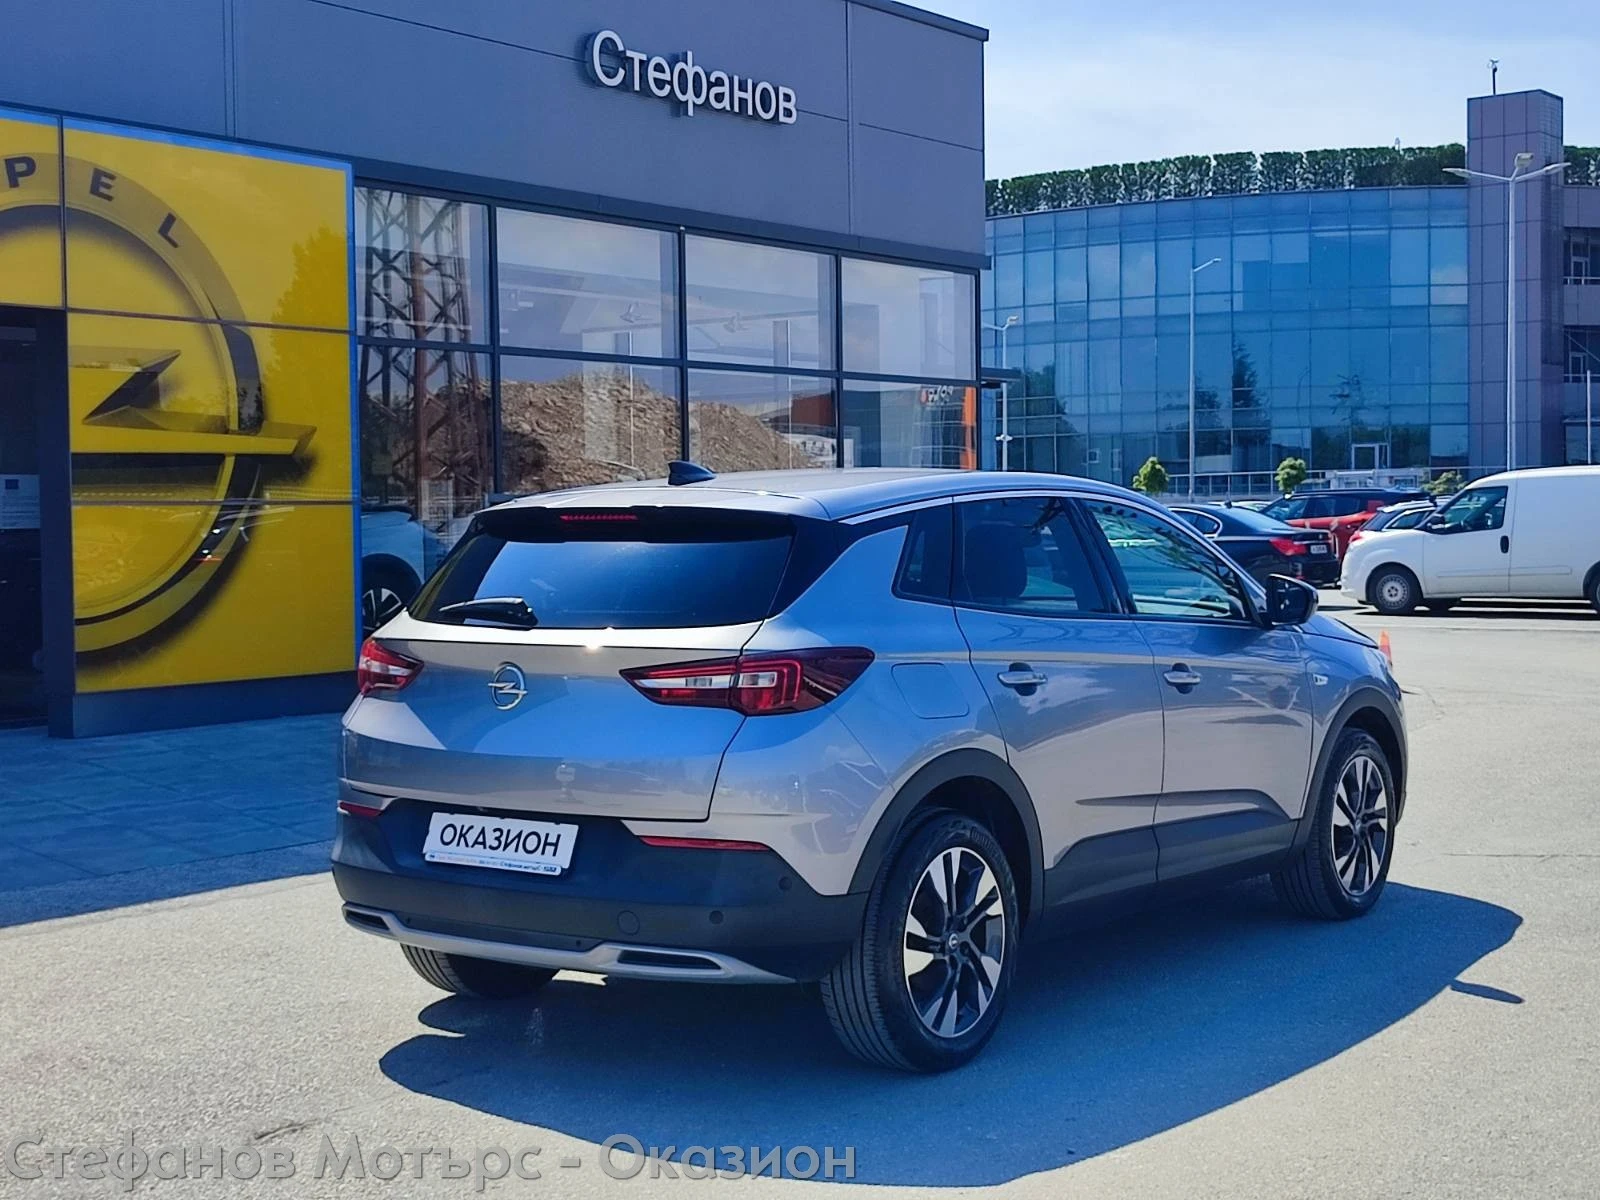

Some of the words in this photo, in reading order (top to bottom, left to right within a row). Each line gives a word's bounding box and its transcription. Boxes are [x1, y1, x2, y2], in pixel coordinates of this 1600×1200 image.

[593, 29, 797, 125] Стефанов
[4, 155, 179, 249] PEL
[440, 823, 561, 857] ОКАЗИОН
